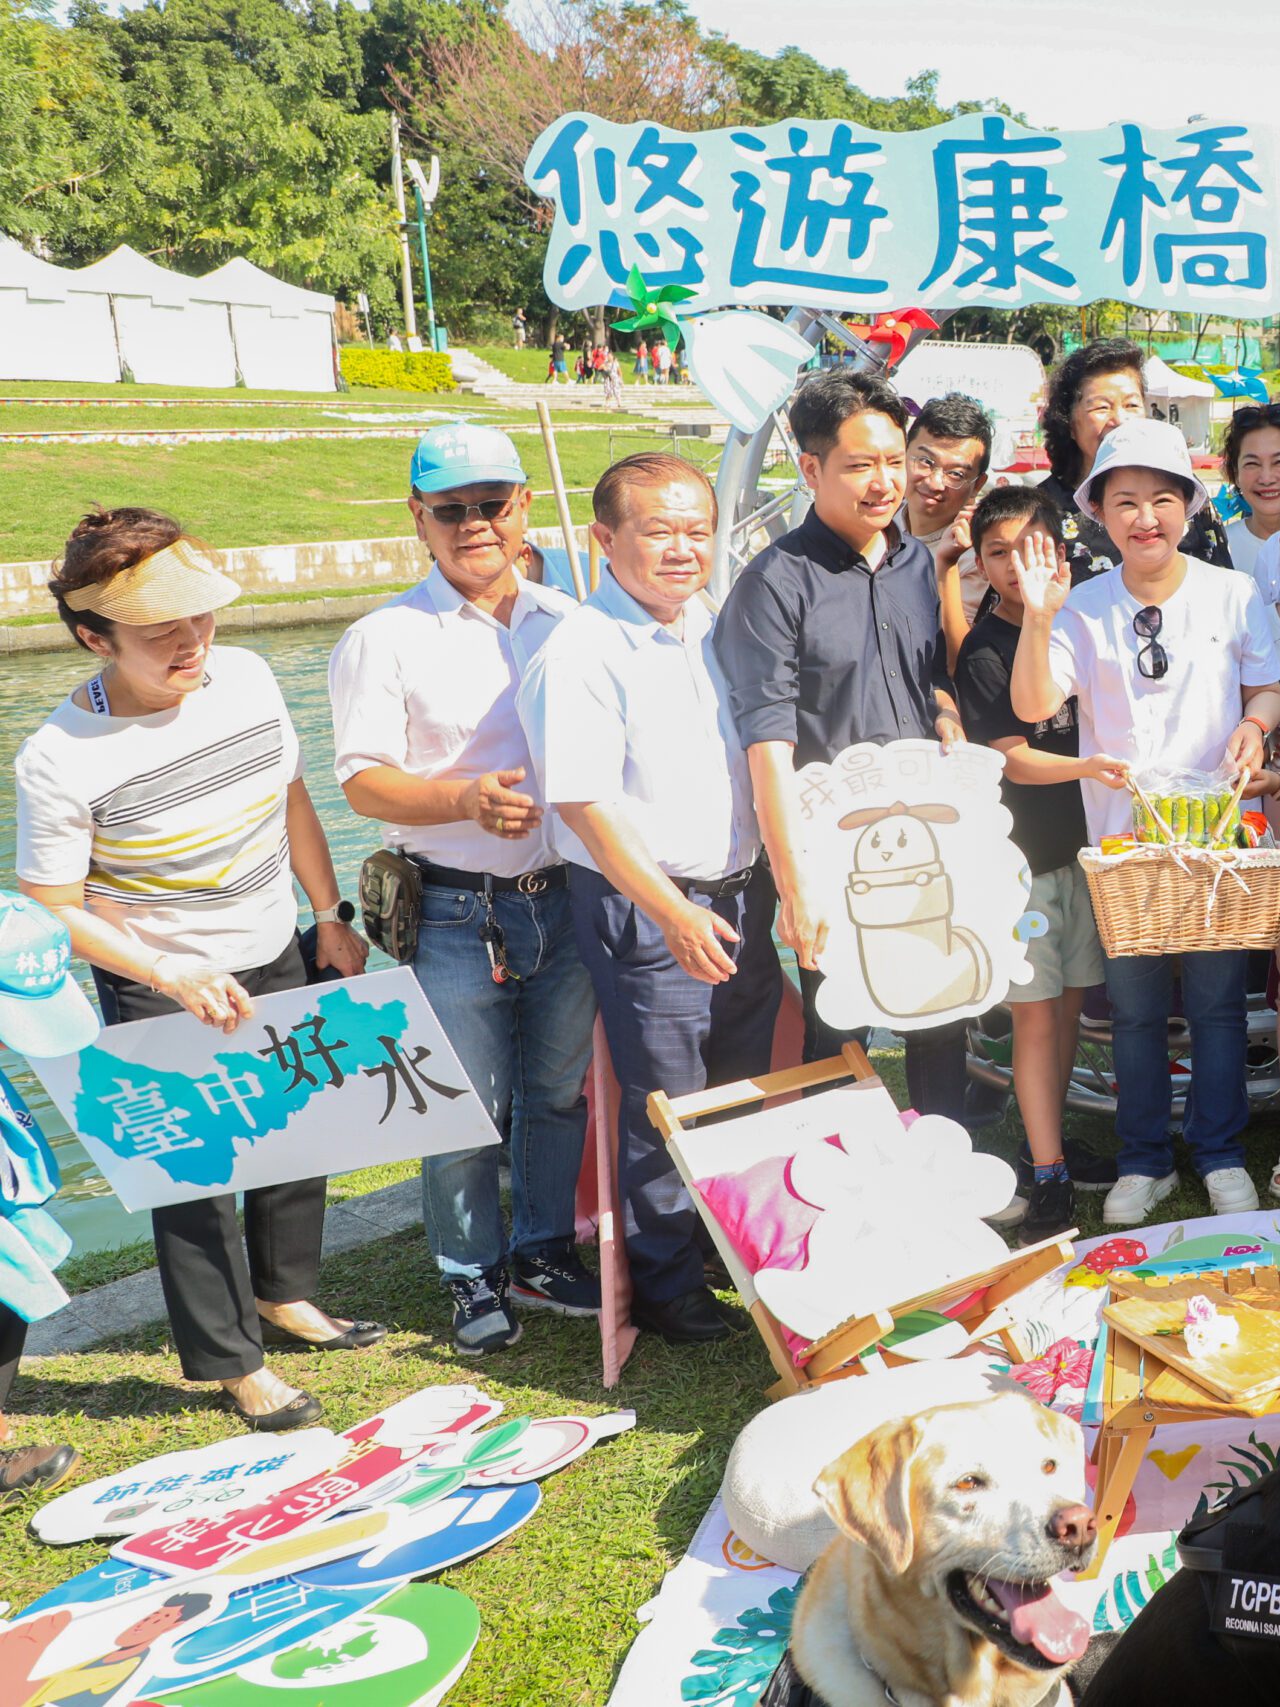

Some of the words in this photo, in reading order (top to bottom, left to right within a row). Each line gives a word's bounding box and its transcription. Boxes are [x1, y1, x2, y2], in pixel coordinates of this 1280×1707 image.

[97, 1014, 471, 1161] 臺中好水
[92, 1452, 296, 1505] 節能減碳
